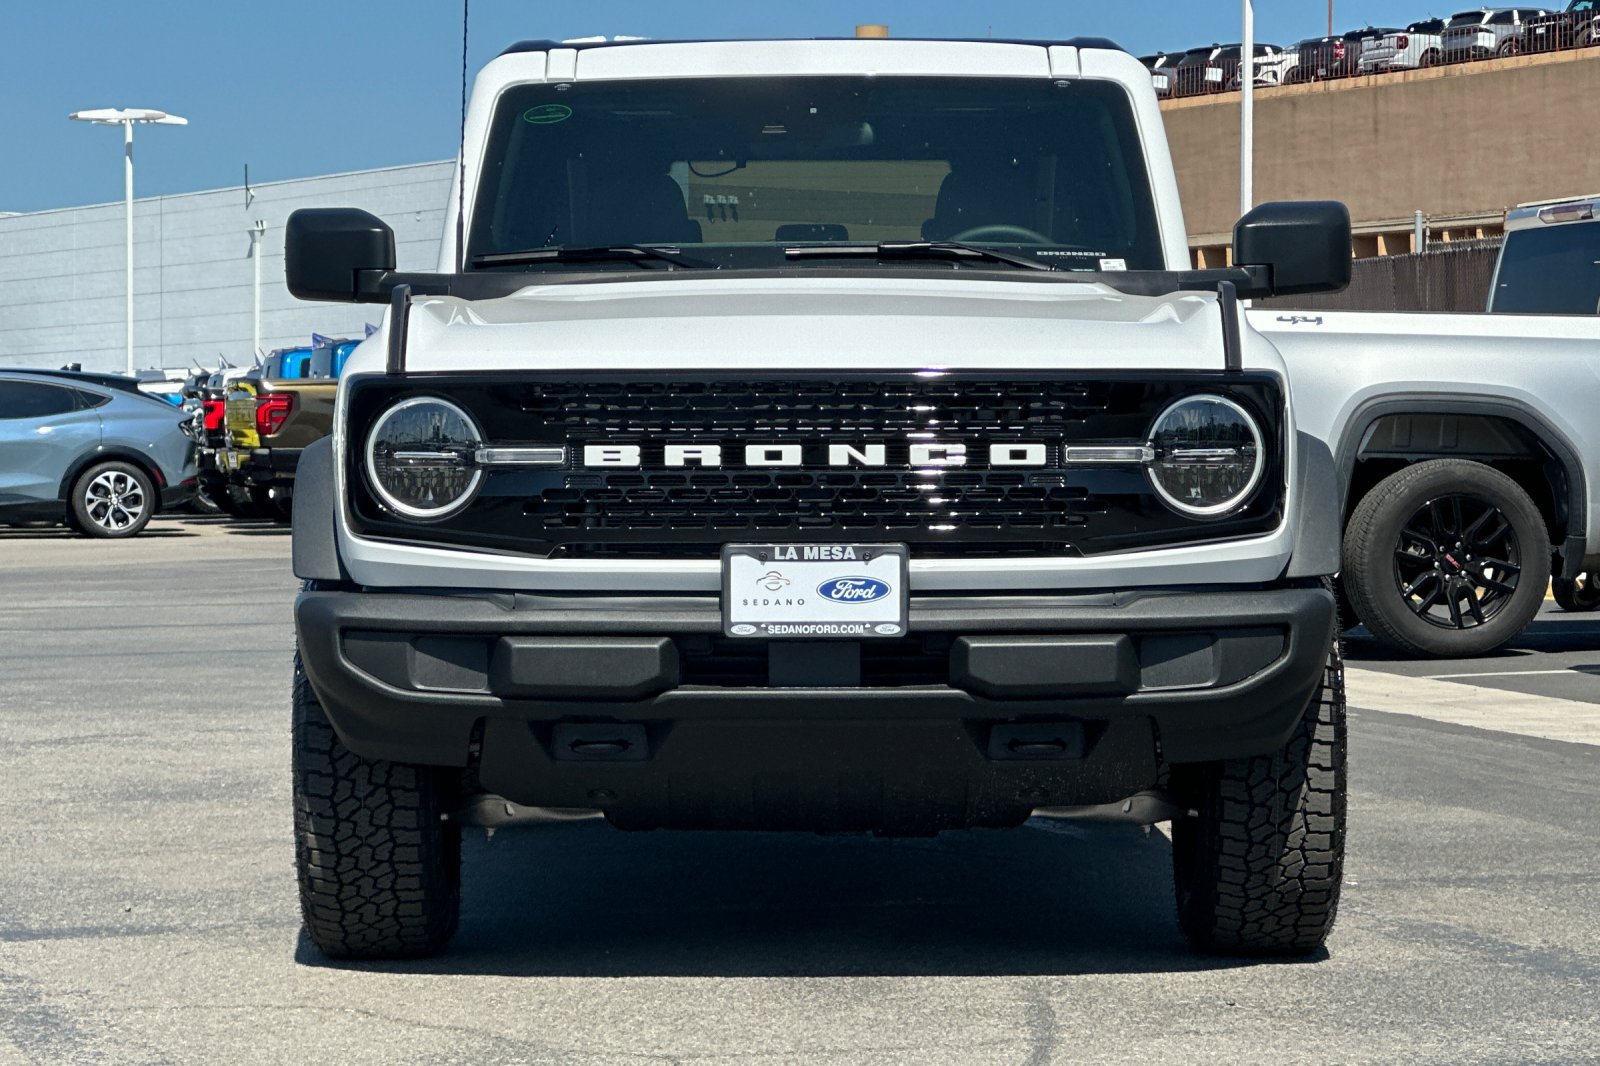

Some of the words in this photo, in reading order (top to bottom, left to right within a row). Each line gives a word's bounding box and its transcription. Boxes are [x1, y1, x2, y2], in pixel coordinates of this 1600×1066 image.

[584, 444, 1047, 466] BRONCO
[774, 546, 798, 560] LA
[803, 546, 857, 560] MESA
[831, 580, 877, 599] Ford
[742, 598, 805, 606] SEDANO
[767, 624, 864, 634] SEDANOFORD.COM
